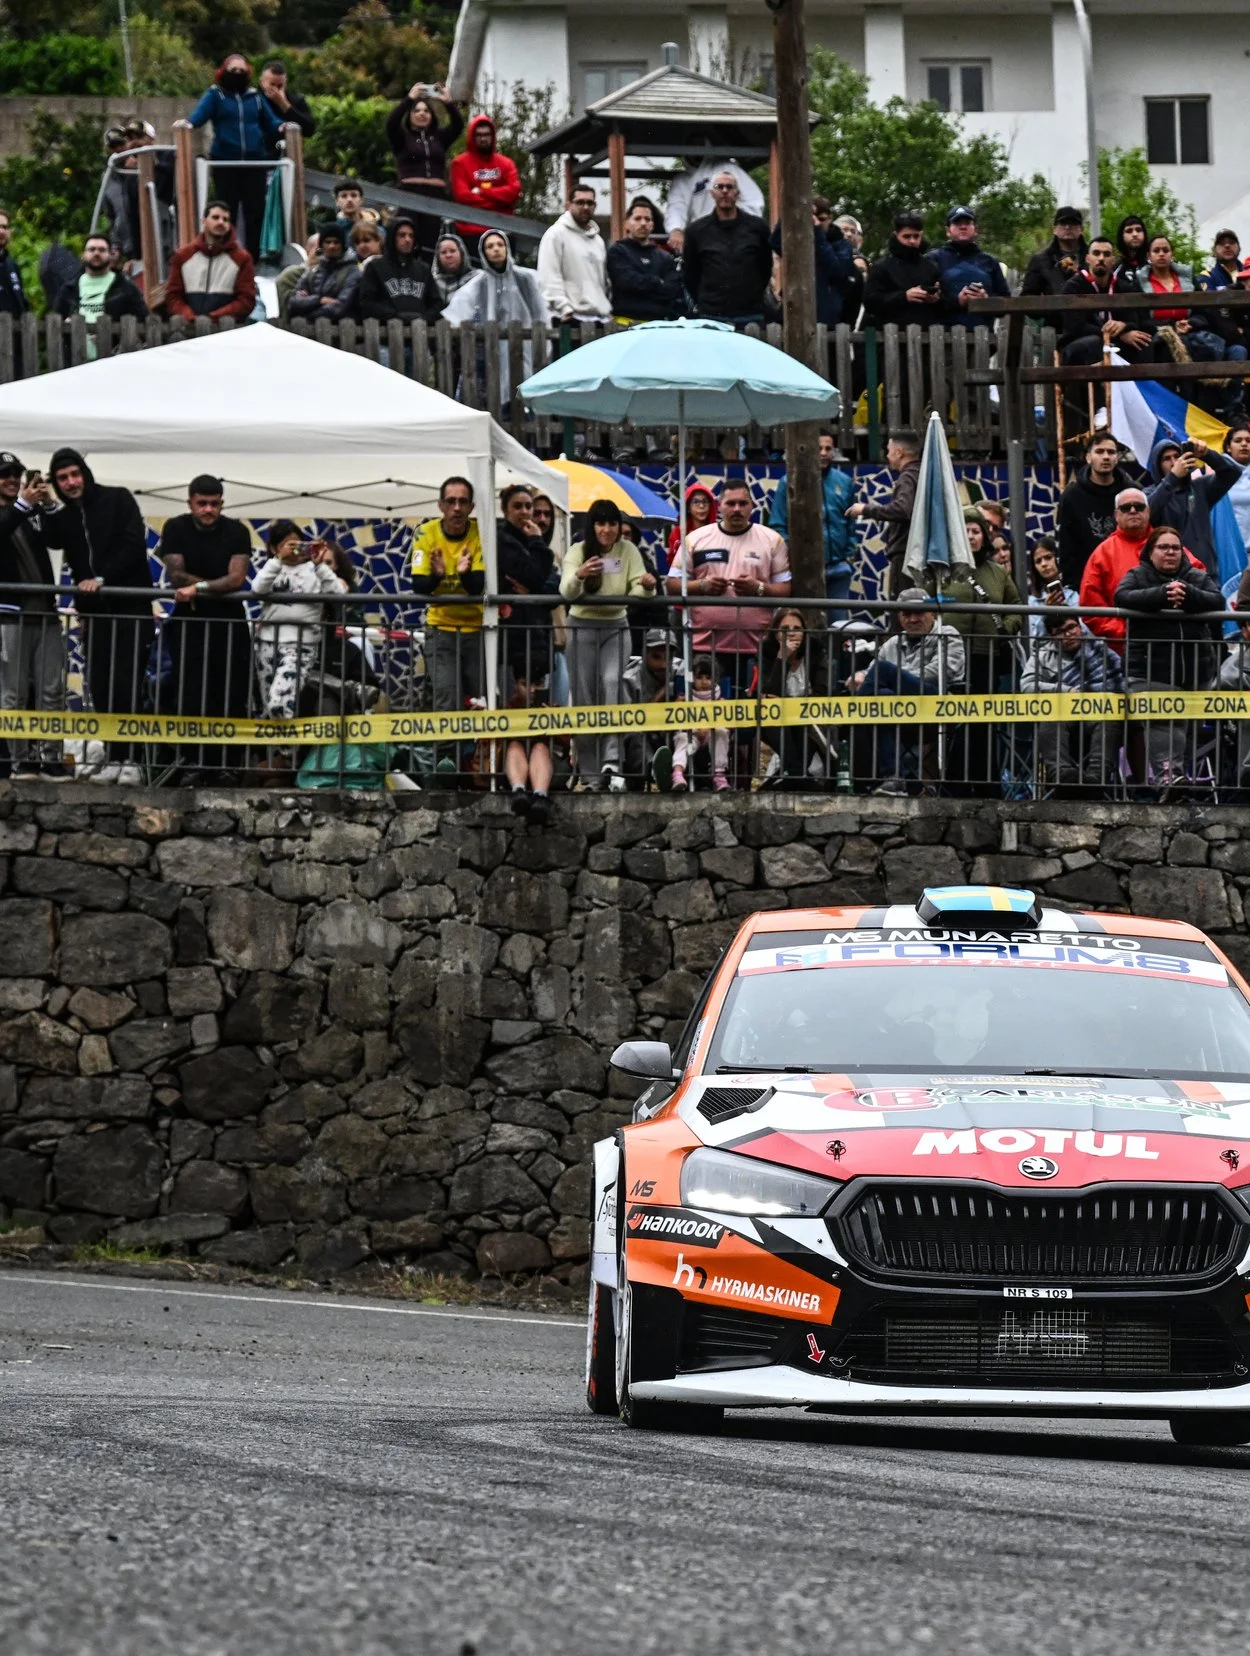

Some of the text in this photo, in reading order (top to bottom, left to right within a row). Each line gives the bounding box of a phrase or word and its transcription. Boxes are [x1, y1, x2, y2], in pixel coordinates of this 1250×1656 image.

[800, 701, 917, 719] ZONA PUBLICO
[936, 700, 1052, 717] ZONA PUBLICO
[1071, 697, 1185, 715] ZONA PUBLICO
[1204, 698, 1247, 713] ZONA
[391, 714, 509, 735] ZONA PUBLICO
[528, 709, 646, 730] ZONA PUBLICO
[664, 707, 707, 724] ZONA
[29, 717, 100, 735] PUBLICO
[117, 719, 236, 739] ZONA PUBLICO
[254, 722, 298, 739] ZONA
[822, 930, 1141, 951] MS MUNARETTO
[841, 944, 1191, 974] FORUM8
[912, 1129, 1160, 1160] MOTUL
[630, 1179, 657, 1197] MS
[711, 1276, 821, 1312] HYRMASKINER
[1007, 1288, 1068, 1299] NR S 109
